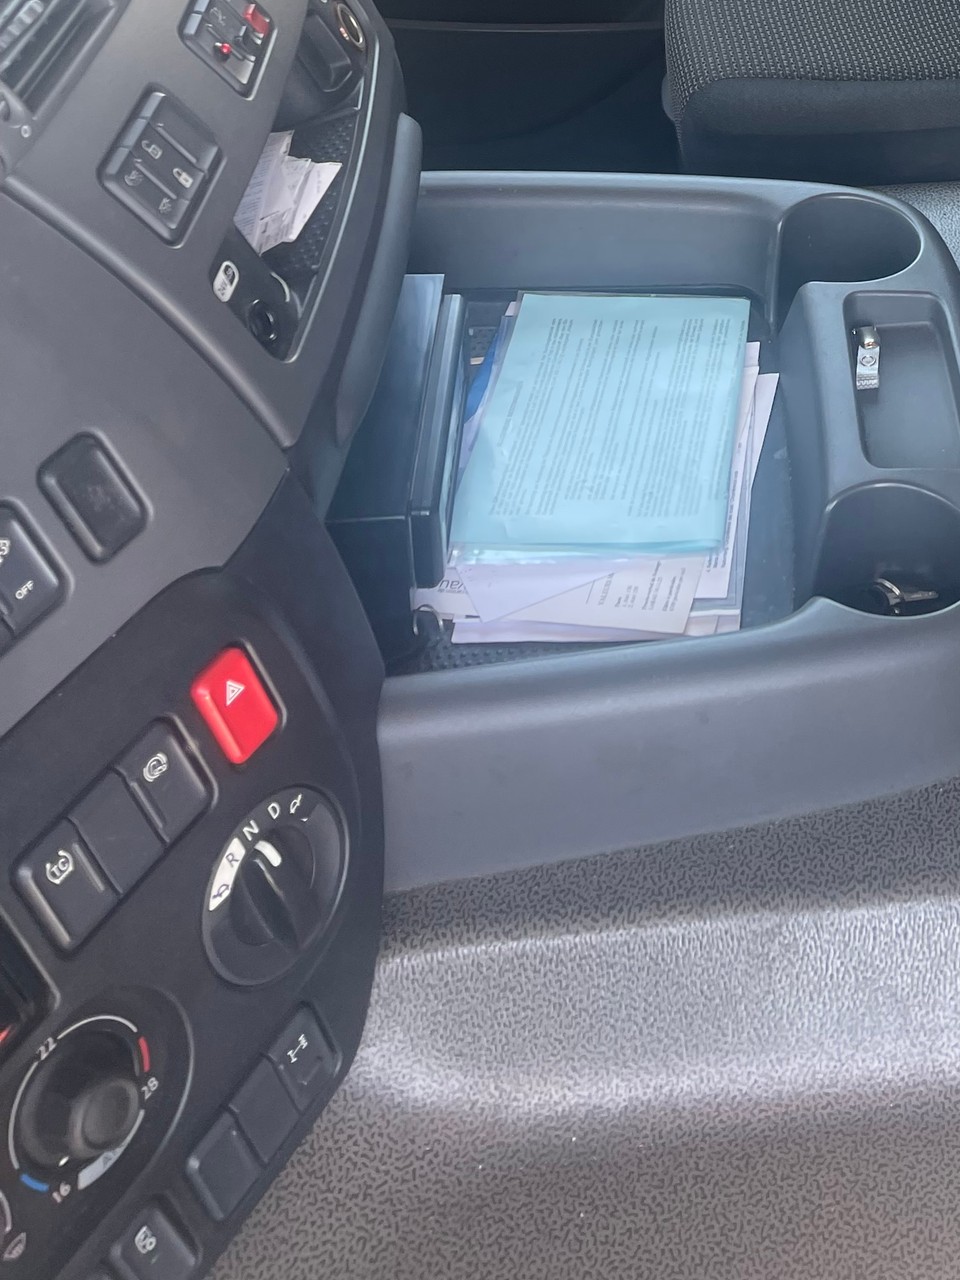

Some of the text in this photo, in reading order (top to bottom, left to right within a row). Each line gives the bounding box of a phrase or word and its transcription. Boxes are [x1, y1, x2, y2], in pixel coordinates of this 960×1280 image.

[15, 580, 34, 600] OFF
[225, 801, 281, 868] R N D
[36, 1036, 58, 1061] 22
[141, 1076, 159, 1100] 28
[52, 1181, 72, 1203] 16
